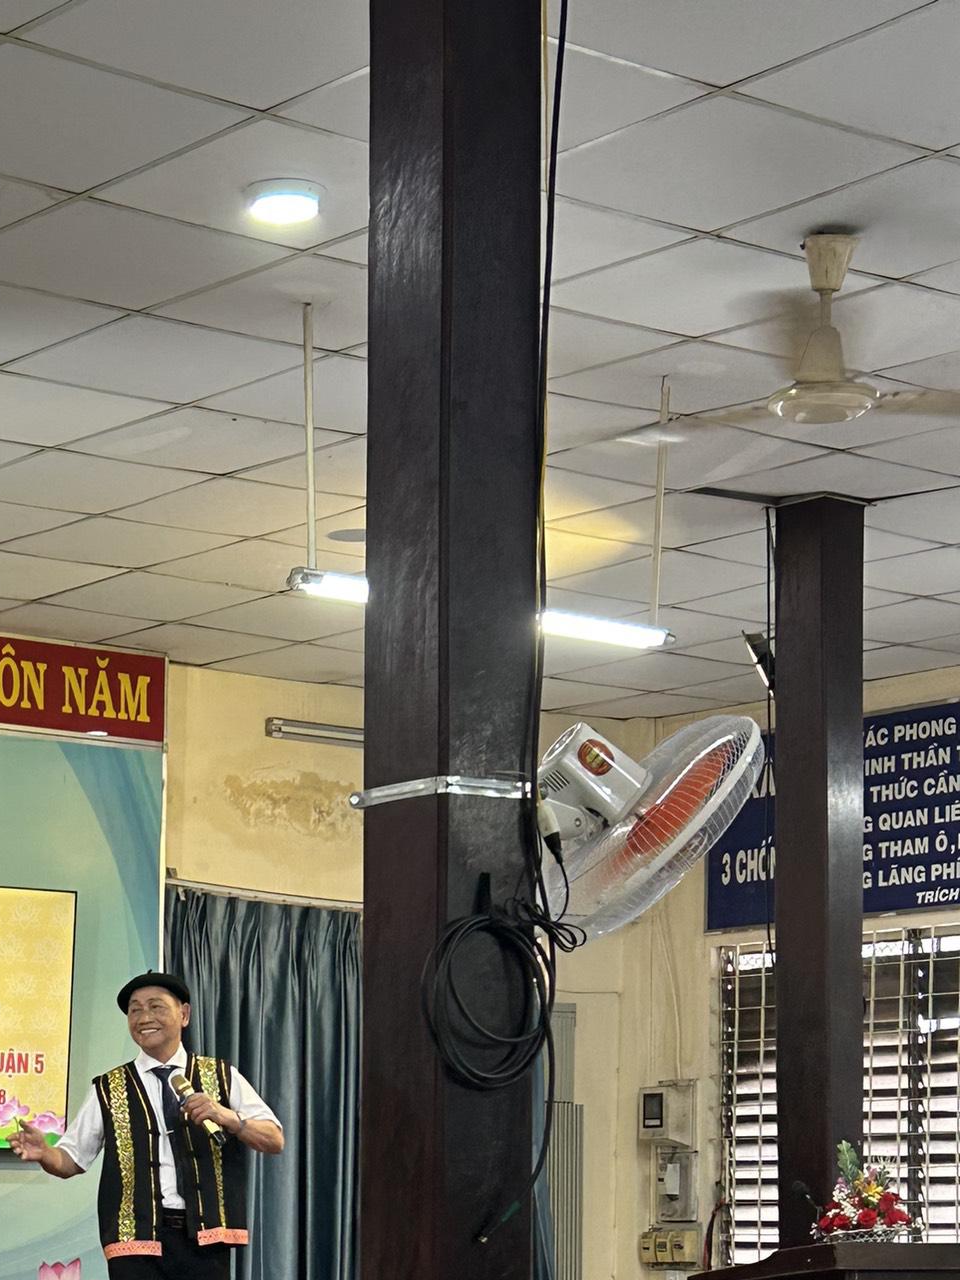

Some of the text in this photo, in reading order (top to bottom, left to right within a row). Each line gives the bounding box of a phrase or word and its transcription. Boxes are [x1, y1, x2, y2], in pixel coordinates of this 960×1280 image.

[61, 656, 151, 723] NĂM
[863, 717, 957, 748] ÁC PHONG
[901, 742, 951, 770] THẦN
[870, 776, 919, 803] THỨC
[878, 808, 929, 831] QUAN
[878, 836, 929, 858] THAM
[721, 852, 732, 886] 3
[878, 864, 926, 887] LÃNG
[916, 886, 960, 904] TRÍCH
[34, 1053, 44, 1074] 5
